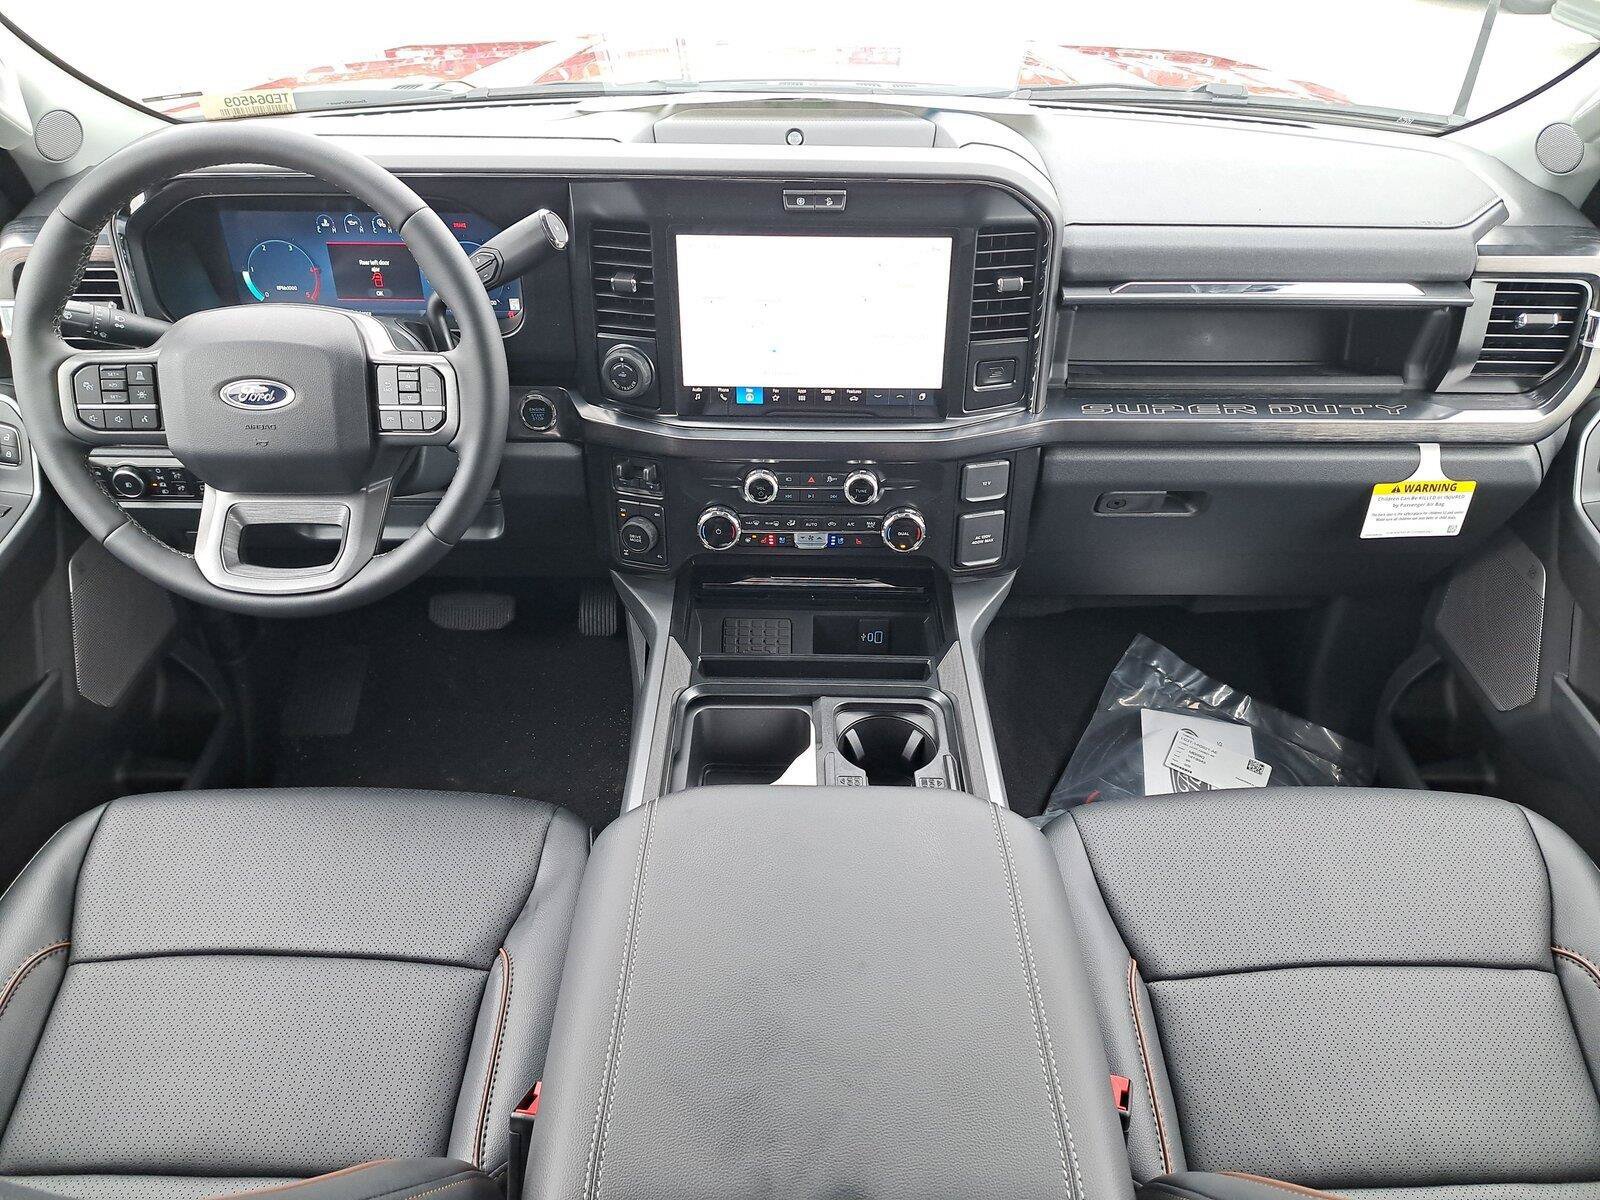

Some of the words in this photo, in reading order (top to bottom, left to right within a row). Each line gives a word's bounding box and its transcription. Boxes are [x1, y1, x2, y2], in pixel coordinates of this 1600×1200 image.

[238, 384, 276, 402] Ford
[1081, 404, 1258, 414] SUPER
[1268, 404, 1407, 415] DUTY
[1404, 483, 1458, 492] WARNING
